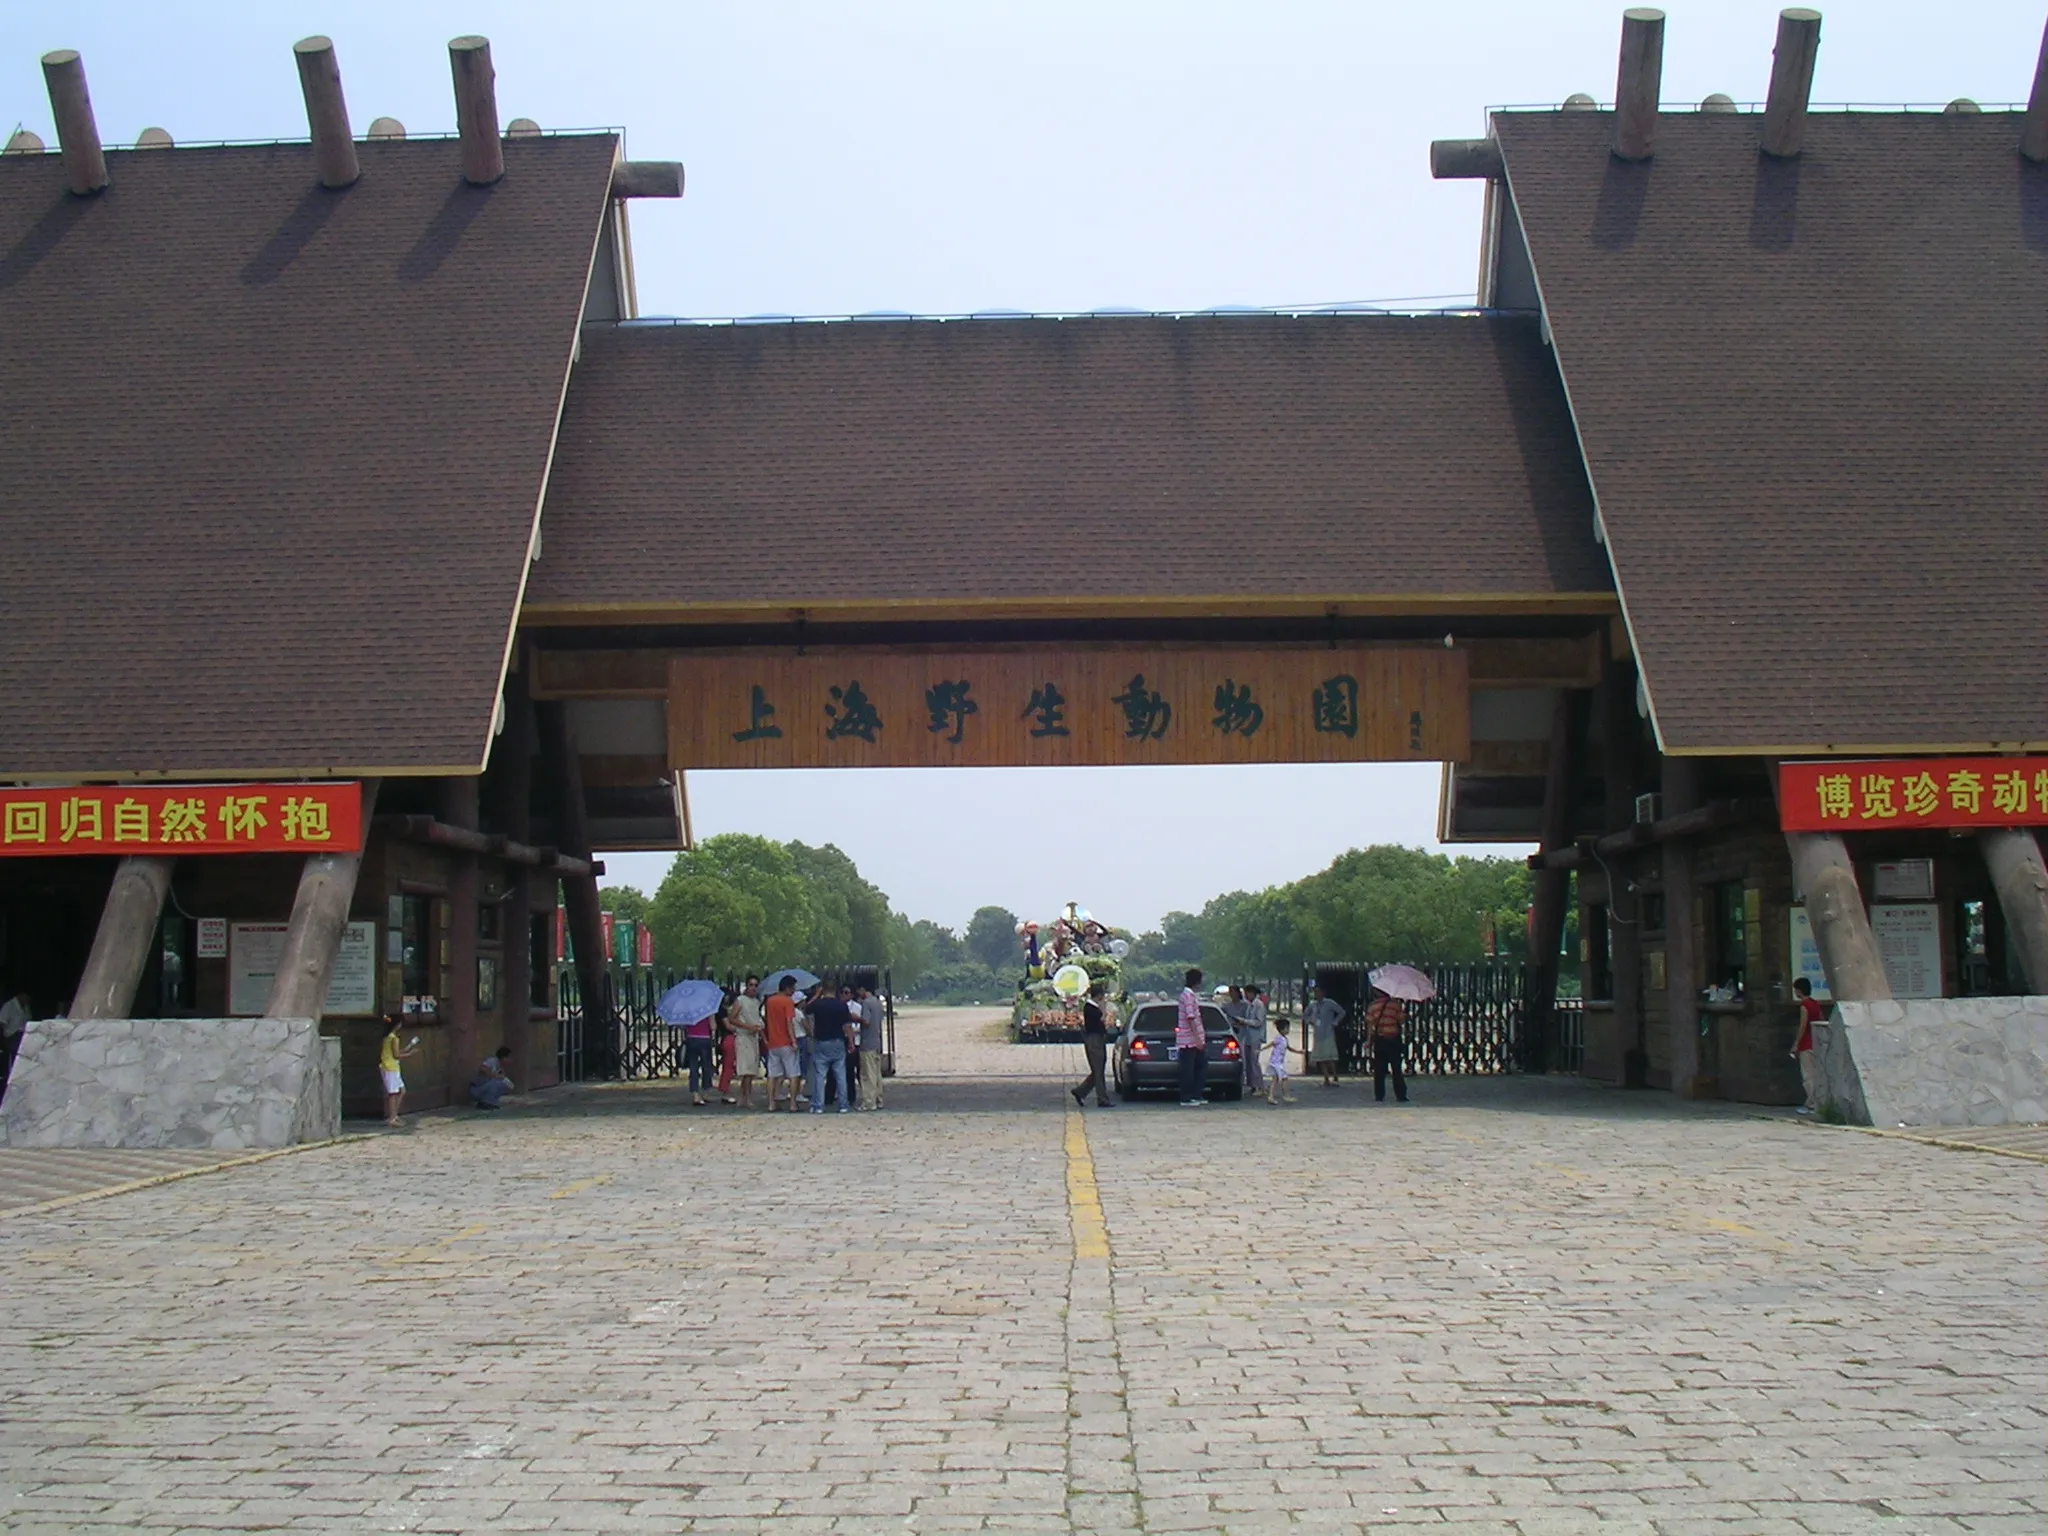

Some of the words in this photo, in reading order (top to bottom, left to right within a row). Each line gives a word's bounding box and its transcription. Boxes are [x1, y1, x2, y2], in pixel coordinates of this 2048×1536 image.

[732, 673, 1360, 744] 上海野生動物園
[3, 796, 332, 843] 回归自然怀抱
